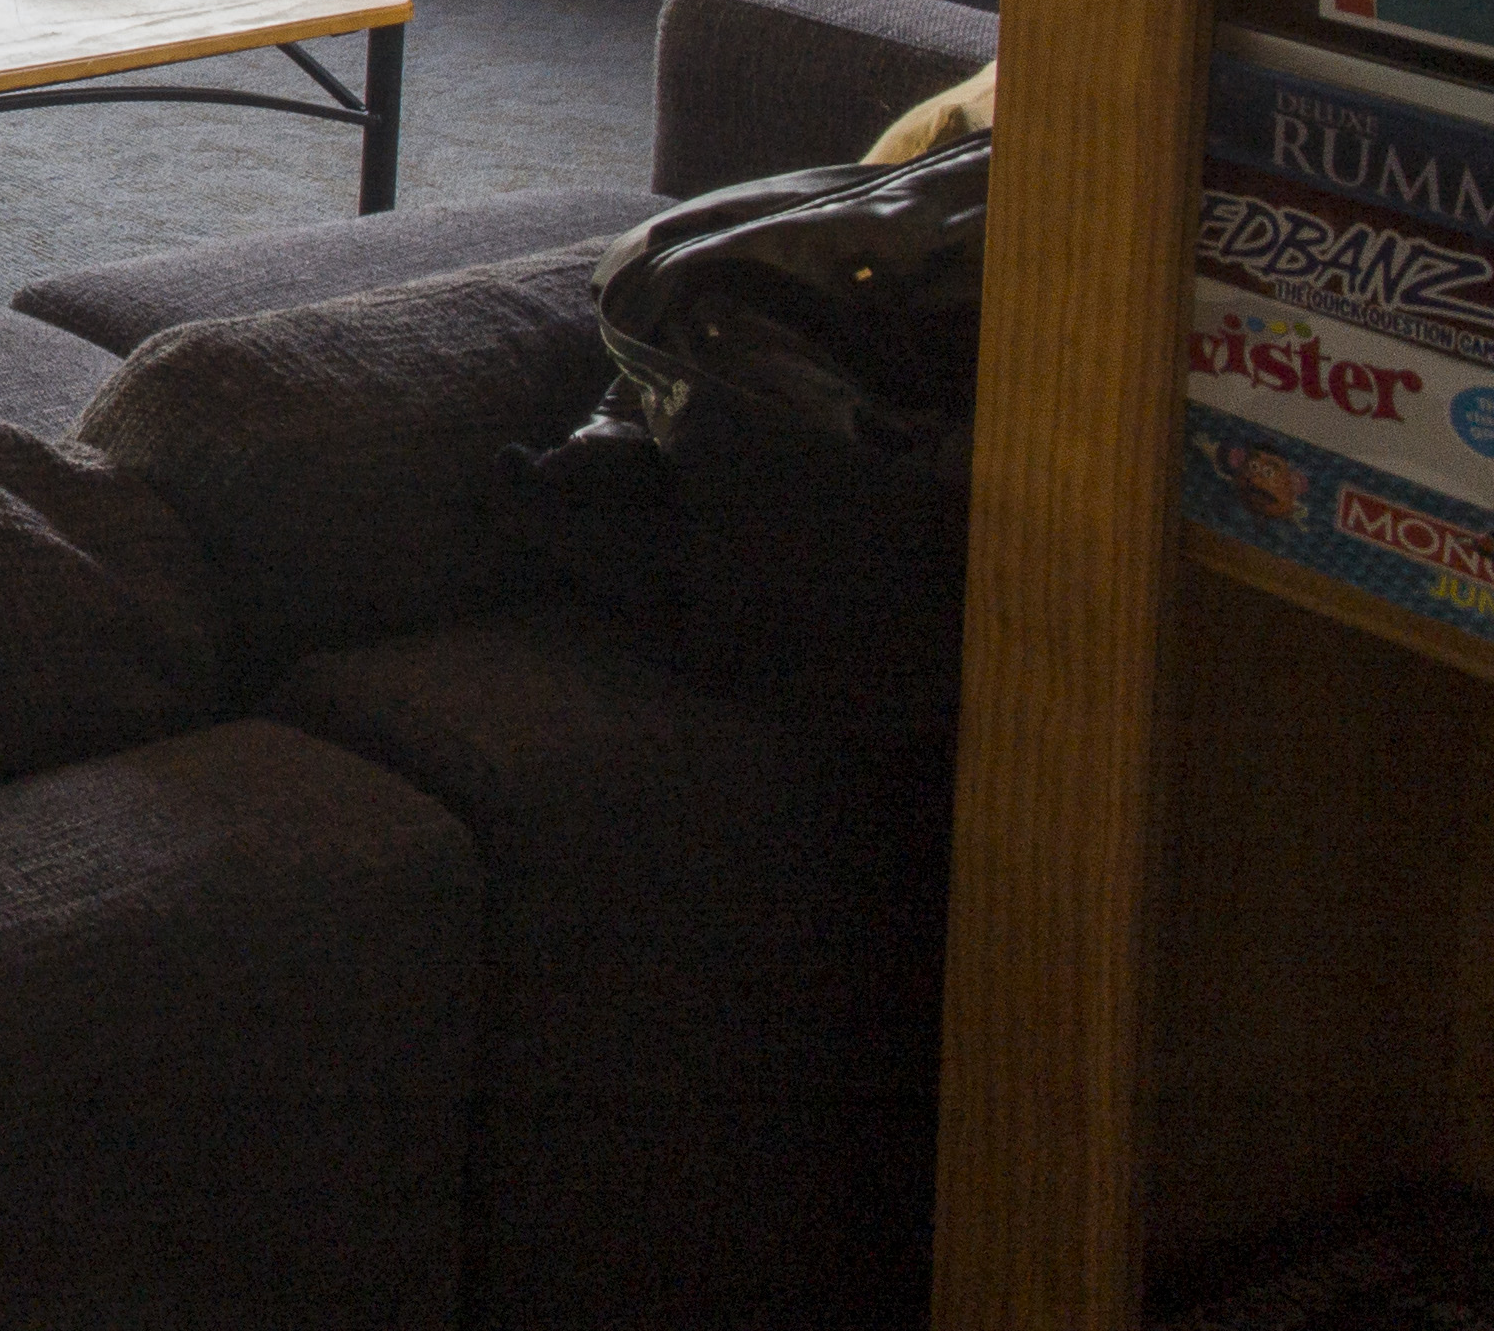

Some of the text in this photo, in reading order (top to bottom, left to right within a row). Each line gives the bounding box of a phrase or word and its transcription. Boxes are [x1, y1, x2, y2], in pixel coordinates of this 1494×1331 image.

[1277, 90, 1380, 137] DELUXE
[1275, 280, 1311, 309] THE
[1311, 291, 1364, 326] QUICK
[1365, 305, 1456, 352] QUESTION
